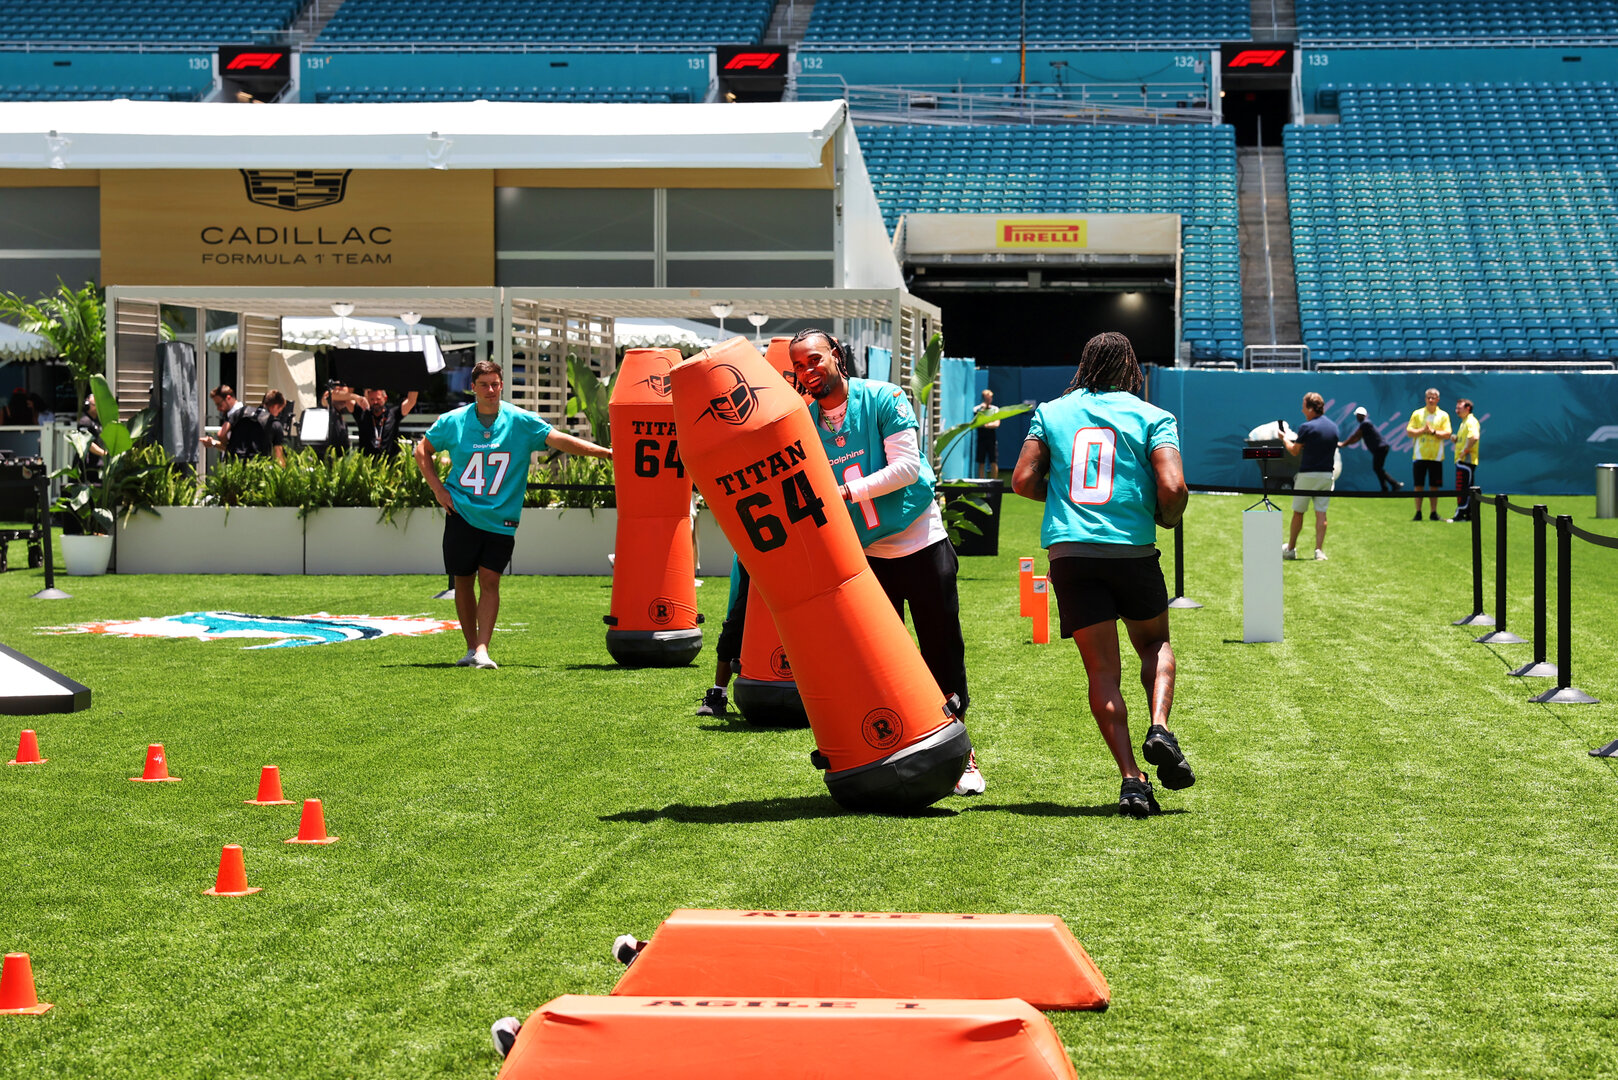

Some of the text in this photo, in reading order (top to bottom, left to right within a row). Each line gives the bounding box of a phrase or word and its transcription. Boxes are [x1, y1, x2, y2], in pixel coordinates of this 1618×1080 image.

[188, 58, 209, 70] 130
[226, 53, 283, 70] F1
[306, 58, 324, 69] 131
[688, 58, 705, 69] 131
[724, 53, 781, 69] F1
[803, 58, 823, 69] 132
[1174, 56, 1194, 67] 132
[1228, 50, 1287, 67] F1
[1308, 54, 1328, 66] 133
[201, 226, 392, 245] CADILLAC
[1003, 225, 1080, 242] PIRELLI
[202, 253, 307, 264] FORMULA
[332, 253, 392, 264] TEAM
[632, 421, 678, 436] TITA
[635, 439, 685, 479] 64
[1069, 426, 1117, 505] 0
[459, 452, 511, 496] 47
[715, 439, 807, 496] TITAN
[842, 462, 881, 530] 1
[735, 469, 828, 553] 64
[872, 719, 893, 740] R
[740, 911, 921, 919] AGILE
[641, 1000, 927, 1010] AGILE 1
